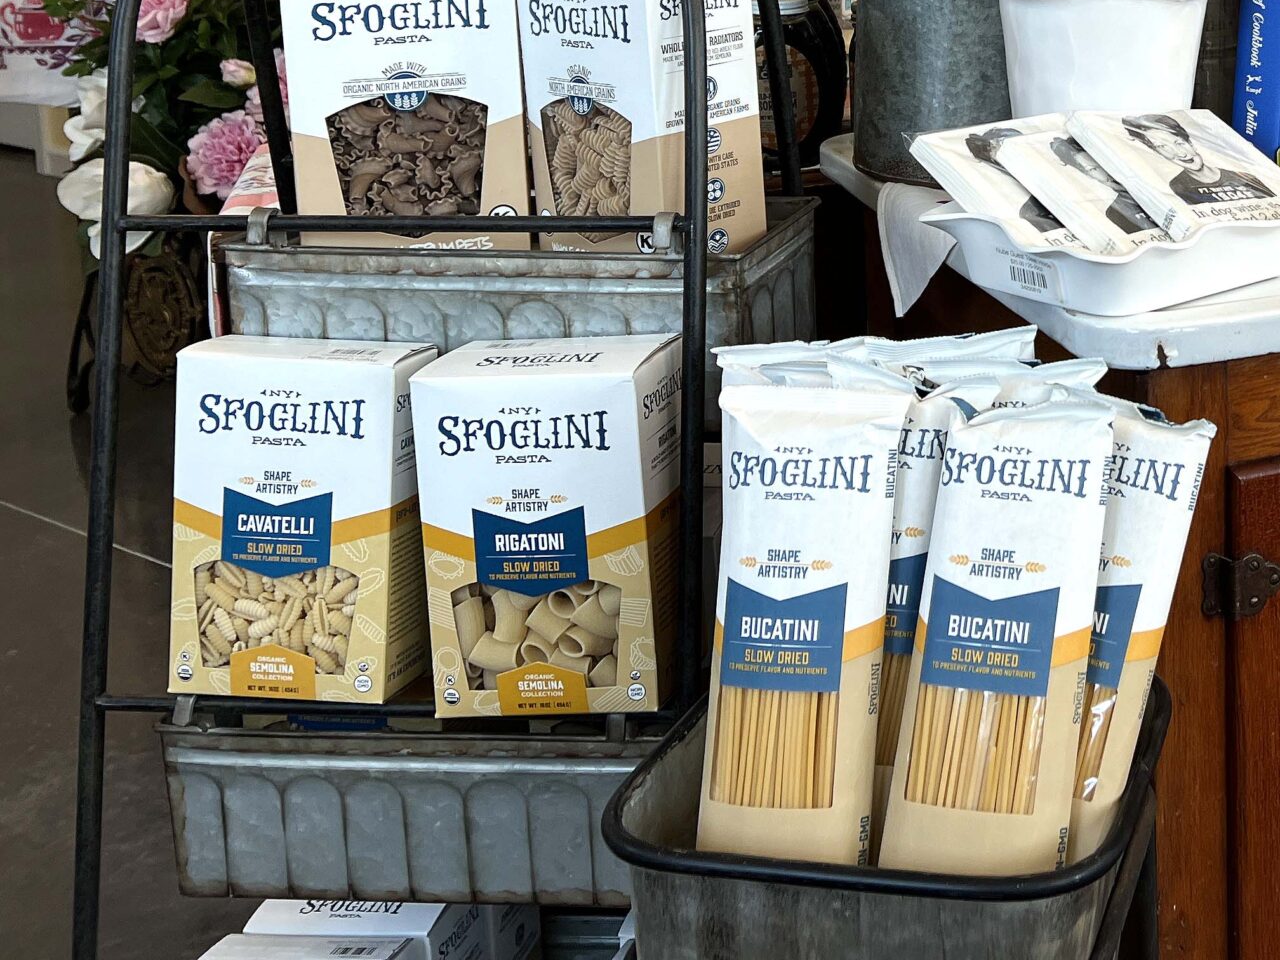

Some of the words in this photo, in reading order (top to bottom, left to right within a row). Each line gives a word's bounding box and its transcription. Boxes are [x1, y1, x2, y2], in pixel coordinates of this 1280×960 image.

[374, 34, 432, 46] PASTA
[560, 38, 594, 50] PASTA
[709, 31, 744, 47] RADIATORS
[1249, 12, 1265, 68] Cookbook
[381, 61, 404, 77] MADE
[406, 61, 427, 74] WITH
[566, 64, 592, 79] ORGANIC
[343, 83, 374, 94] ORGANIC
[376, 81, 400, 92] NORTH
[402, 79, 440, 90] AMERICAN
[441, 76, 467, 87] GRAINS
[548, 81, 565, 93] NORTH
[566, 83, 593, 96] AMERICAN
[594, 87, 616, 100] GRAINS
[1245, 98, 1260, 136] Julia
[1192, 209, 1206, 219] In
[1211, 206, 1233, 218] dog
[475, 351, 605, 367] SFOGLINI
[199, 393, 366, 439] SFOGLINI
[252, 436, 307, 447] PASTA
[438, 410, 611, 457] SFOGLINI
[495, 455, 552, 465] PASTA
[263, 470, 292, 482] SHAPE
[729, 450, 873, 493] SFOGLINI
[885, 448, 898, 499] BUCATINI
[942, 448, 1091, 498] SFOGLINI
[1099, 455, 1113, 506] BUCATINI
[1188, 462, 1204, 513] BUCATINI
[256, 483, 299, 495] ARTISTRY
[511, 488, 541, 499] SHAPE
[765, 491, 815, 501] PASTA
[980, 489, 1033, 502] PASTA
[505, 501, 549, 513] ARTISTRY
[238, 513, 315, 536] CAVATELLI
[247, 542, 274, 554] SLOW
[276, 544, 303, 556] DRIED
[495, 532, 565, 552] RIGATONI
[767, 549, 801, 562] SHAPE
[980, 548, 1016, 563] SHAPE
[503, 561, 531, 572] SLOW
[533, 560, 560, 572] DRIED
[757, 565, 809, 579] ARTISTRY
[969, 563, 1023, 580] ARTISTRY
[741, 616, 819, 641] BUCATINI
[948, 614, 1030, 645] BUCATINI
[744, 649, 774, 664] SLOW
[777, 650, 810, 665] DRIED
[951, 648, 984, 664] SLOW
[987, 651, 1019, 668] DRIED
[250, 662, 294, 674] SEMOLINA
[735, 663, 759, 672] PRESERVE
[760, 664, 782, 673] FLAVOR
[783, 666, 794, 674] AND
[795, 666, 828, 675] NUTRIENTS
[940, 662, 968, 673] PRESERVE
[968, 665, 990, 674] FLAVOR
[991, 668, 1003, 676] AND
[1004, 669, 1036, 679] NUTRIENTS
[518, 680, 564, 691] SEMOLINA
[299, 899, 404, 915] SFOGLINI
